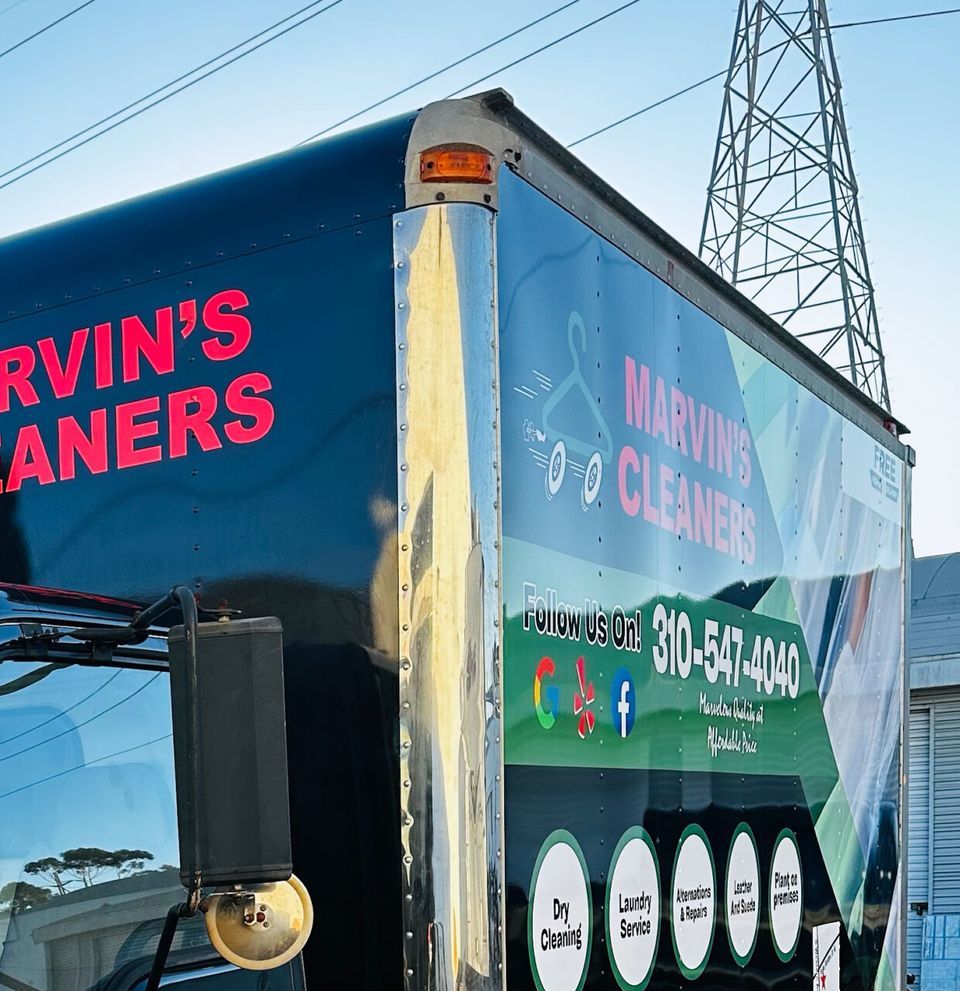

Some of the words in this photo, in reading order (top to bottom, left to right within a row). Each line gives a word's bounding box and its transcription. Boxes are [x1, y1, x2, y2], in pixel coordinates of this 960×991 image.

[625, 355, 752, 488] MARVIN'S
[618, 445, 756, 565] CLEANERS
[522, 581, 581, 642] Follow
[584, 598, 608, 648] Us
[611, 604, 641, 653] On!
[652, 603, 800, 700] 310-547-4040
[734, 880, 753, 895] Leather
[774, 872, 790, 890] Plant
[553, 898, 569, 925] Dry
[619, 891, 652, 915] Laundry
[730, 900, 740, 916] And
[741, 898, 756, 914] Suede
[773, 890, 799, 911] premises
[680, 907, 685, 921] &
[685, 903, 708, 923] Repairs
[540, 923, 582, 952] Cleaning
[620, 915, 651, 939] Service
